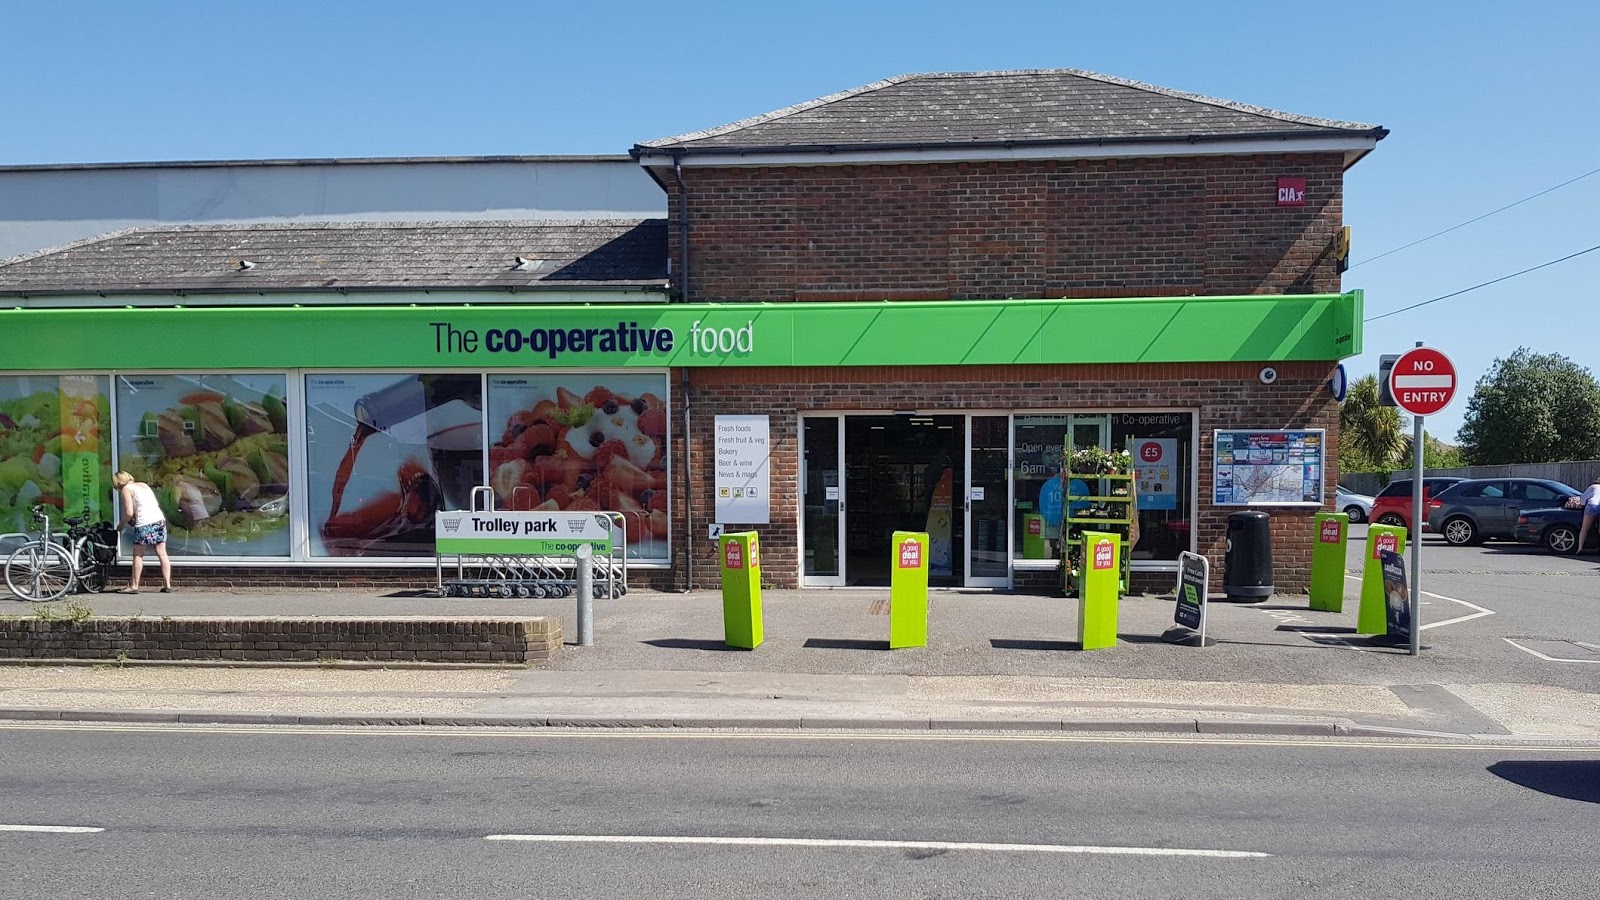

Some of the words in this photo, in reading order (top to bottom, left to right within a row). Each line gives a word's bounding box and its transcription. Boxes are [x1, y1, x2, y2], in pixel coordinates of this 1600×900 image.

[1278, 187, 1296, 202] CIA
[429, 322, 478, 354] The
[485, 321, 674, 359] co-operative
[690, 319, 754, 353] food
[1413, 360, 1434, 371] NO
[1403, 391, 1447, 403] ENTRY
[1078, 412, 1119, 425] Southn
[1121, 414, 1180, 426] Co-operative
[718, 448, 738, 456] Bakery
[1021, 443, 1043, 453] Open
[1045, 444, 1066, 453] ever
[1145, 448, 1158, 457] £5
[1020, 461, 1046, 474] 6am
[472, 518, 519, 535] Trolley
[524, 518, 557, 535] park
[1323, 528, 1338, 536] deal
[540, 541, 554, 551] The
[555, 541, 606, 552] co-optive
[1377, 543, 1395, 552] deal
[727, 551, 740, 560] deal
[902, 550, 918, 559] deal
[1097, 552, 1111, 561] deal
